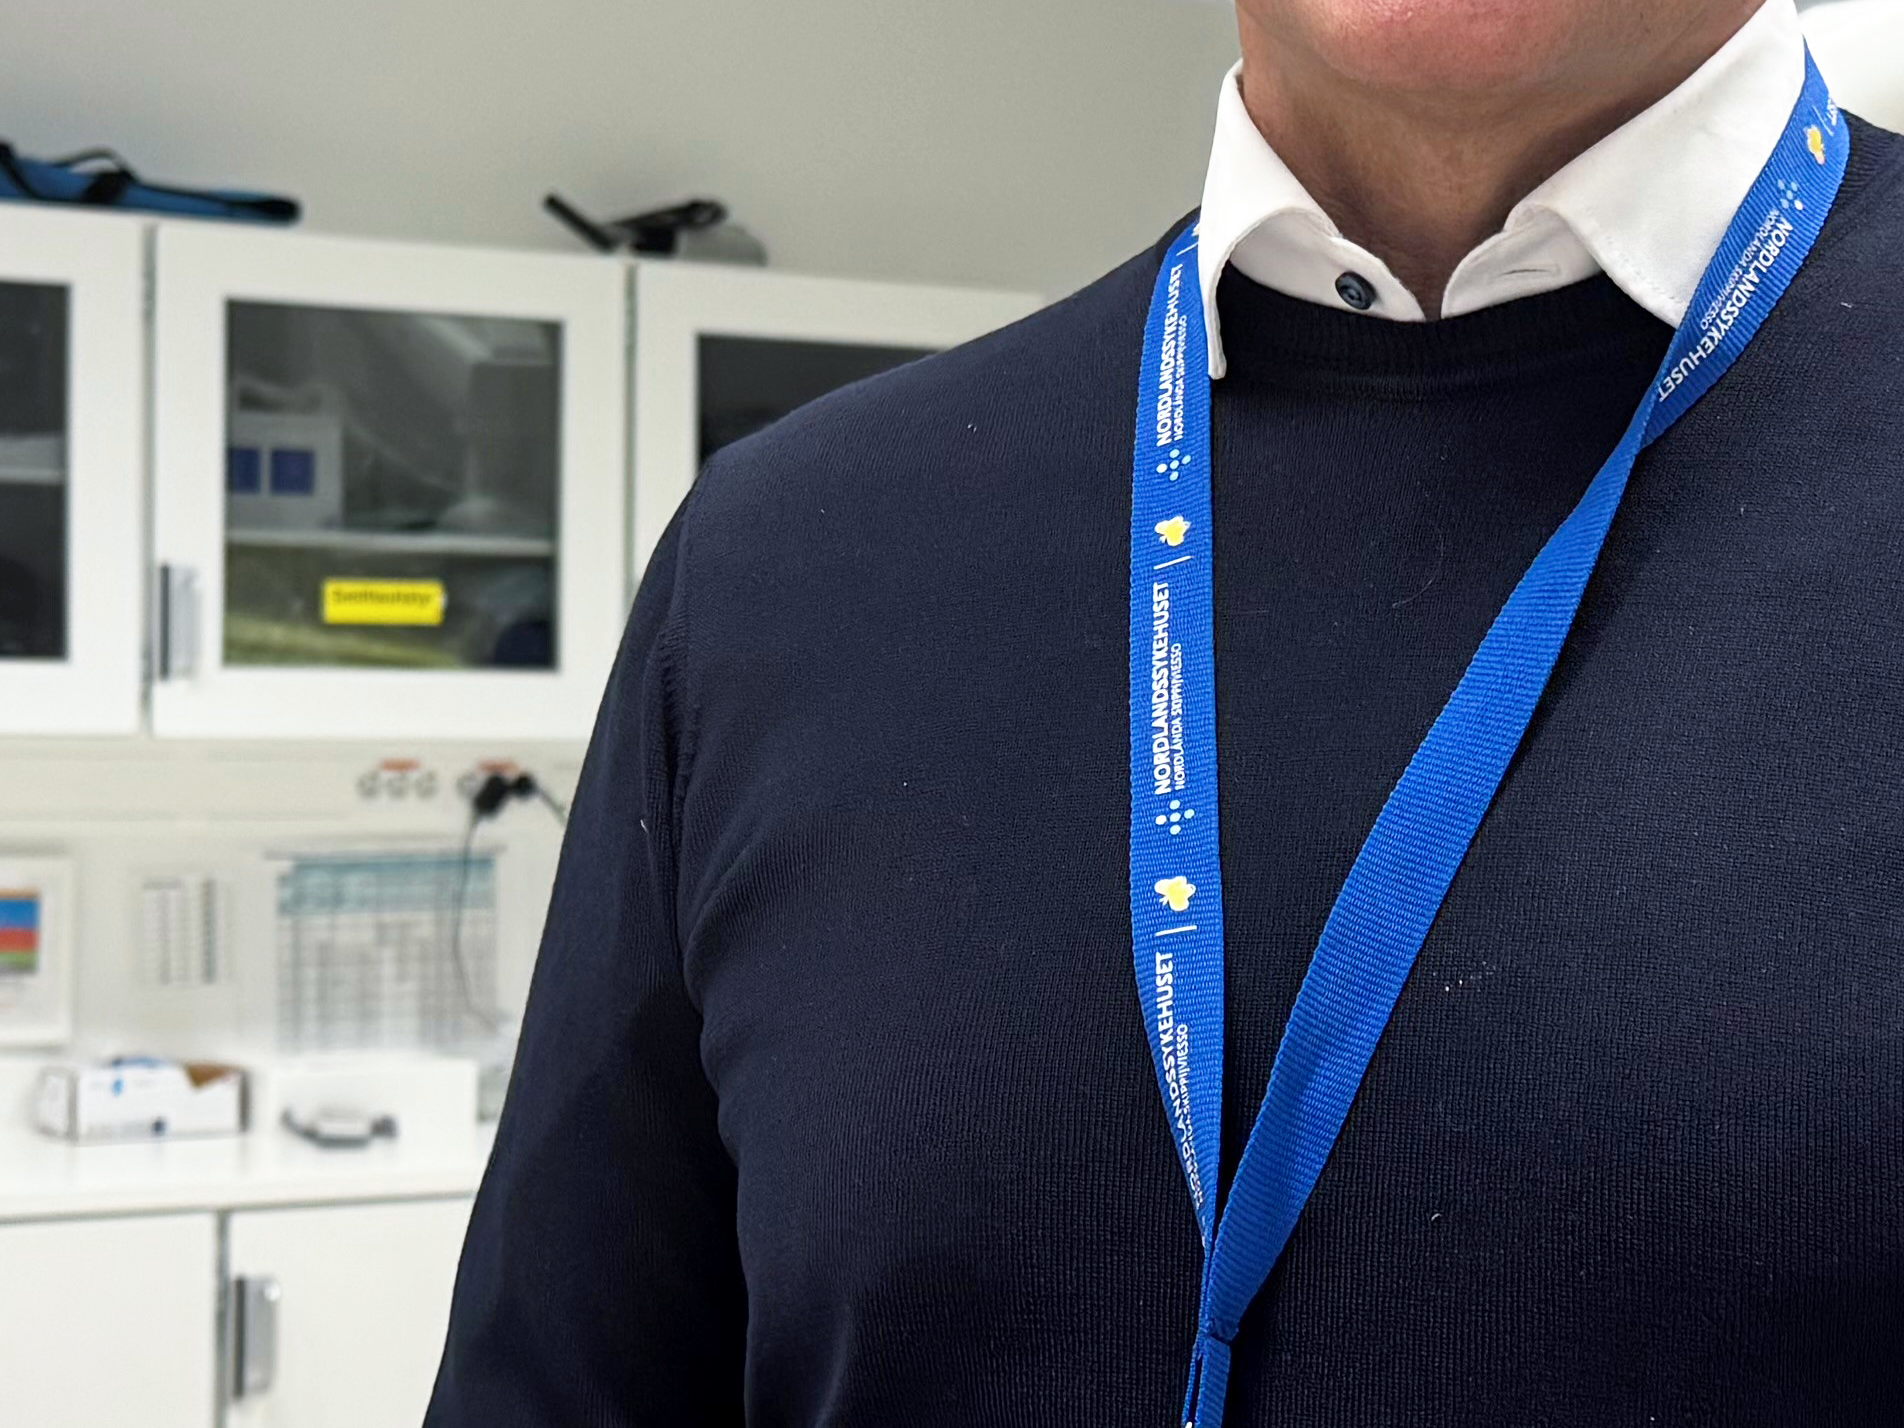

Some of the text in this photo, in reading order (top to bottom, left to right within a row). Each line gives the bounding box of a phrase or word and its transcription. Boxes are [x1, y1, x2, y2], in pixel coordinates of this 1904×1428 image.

[1157, 263, 1184, 447] NORDLANDSSYKEHUSET
[1656, 220, 1793, 403] NORDLANDSSYKEHUSET
[1152, 582, 1170, 796] NORDLANDSSYKEHUSET
